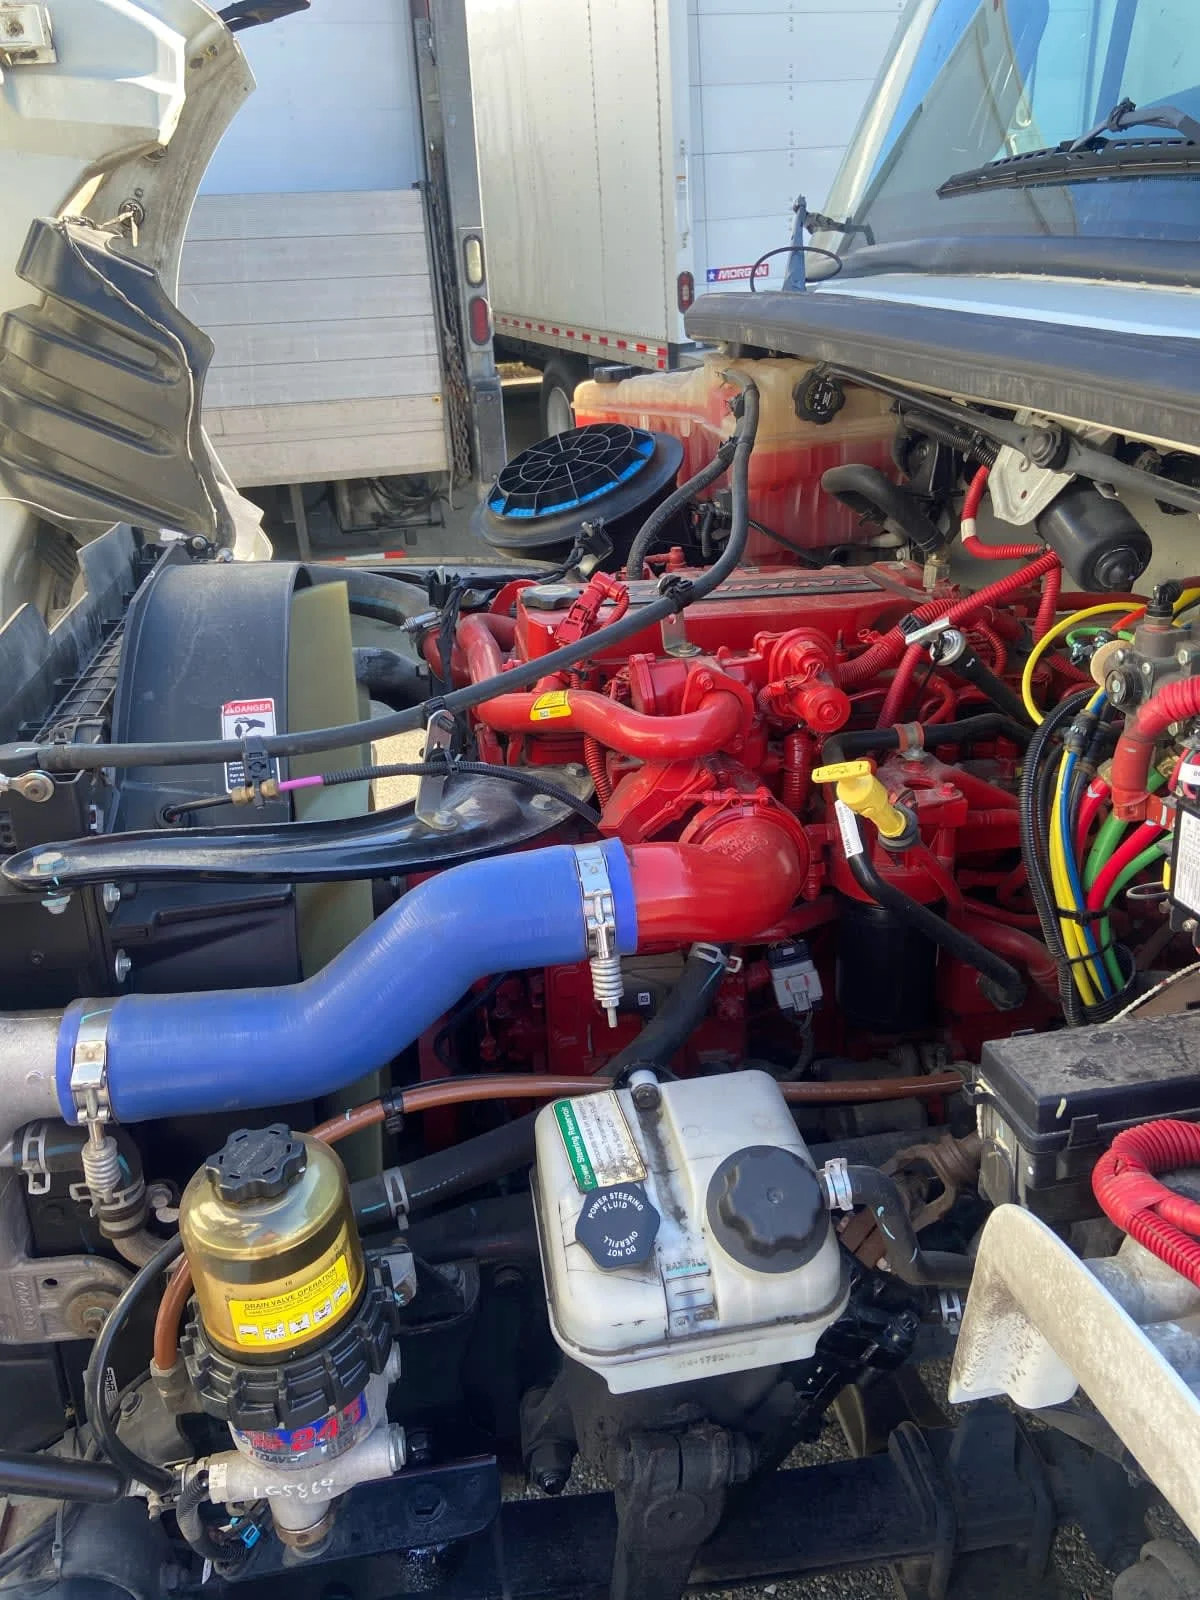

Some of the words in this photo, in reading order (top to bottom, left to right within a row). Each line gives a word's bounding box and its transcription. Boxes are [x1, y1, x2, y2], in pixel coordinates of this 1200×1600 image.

[718, 265, 767, 280] MORGAN
[234, 703, 271, 713] DANGER
[561, 1106, 575, 1136] Reservoir
[580, 1164, 592, 1185] Power
[588, 1195, 609, 1219] POWER
[609, 1191, 644, 1212] STEERING
[602, 1201, 628, 1213] FLUID
[603, 1230, 638, 1248] OVERFILL
[607, 1248, 623, 1257] NOT
[625, 1245, 636, 1256] DO
